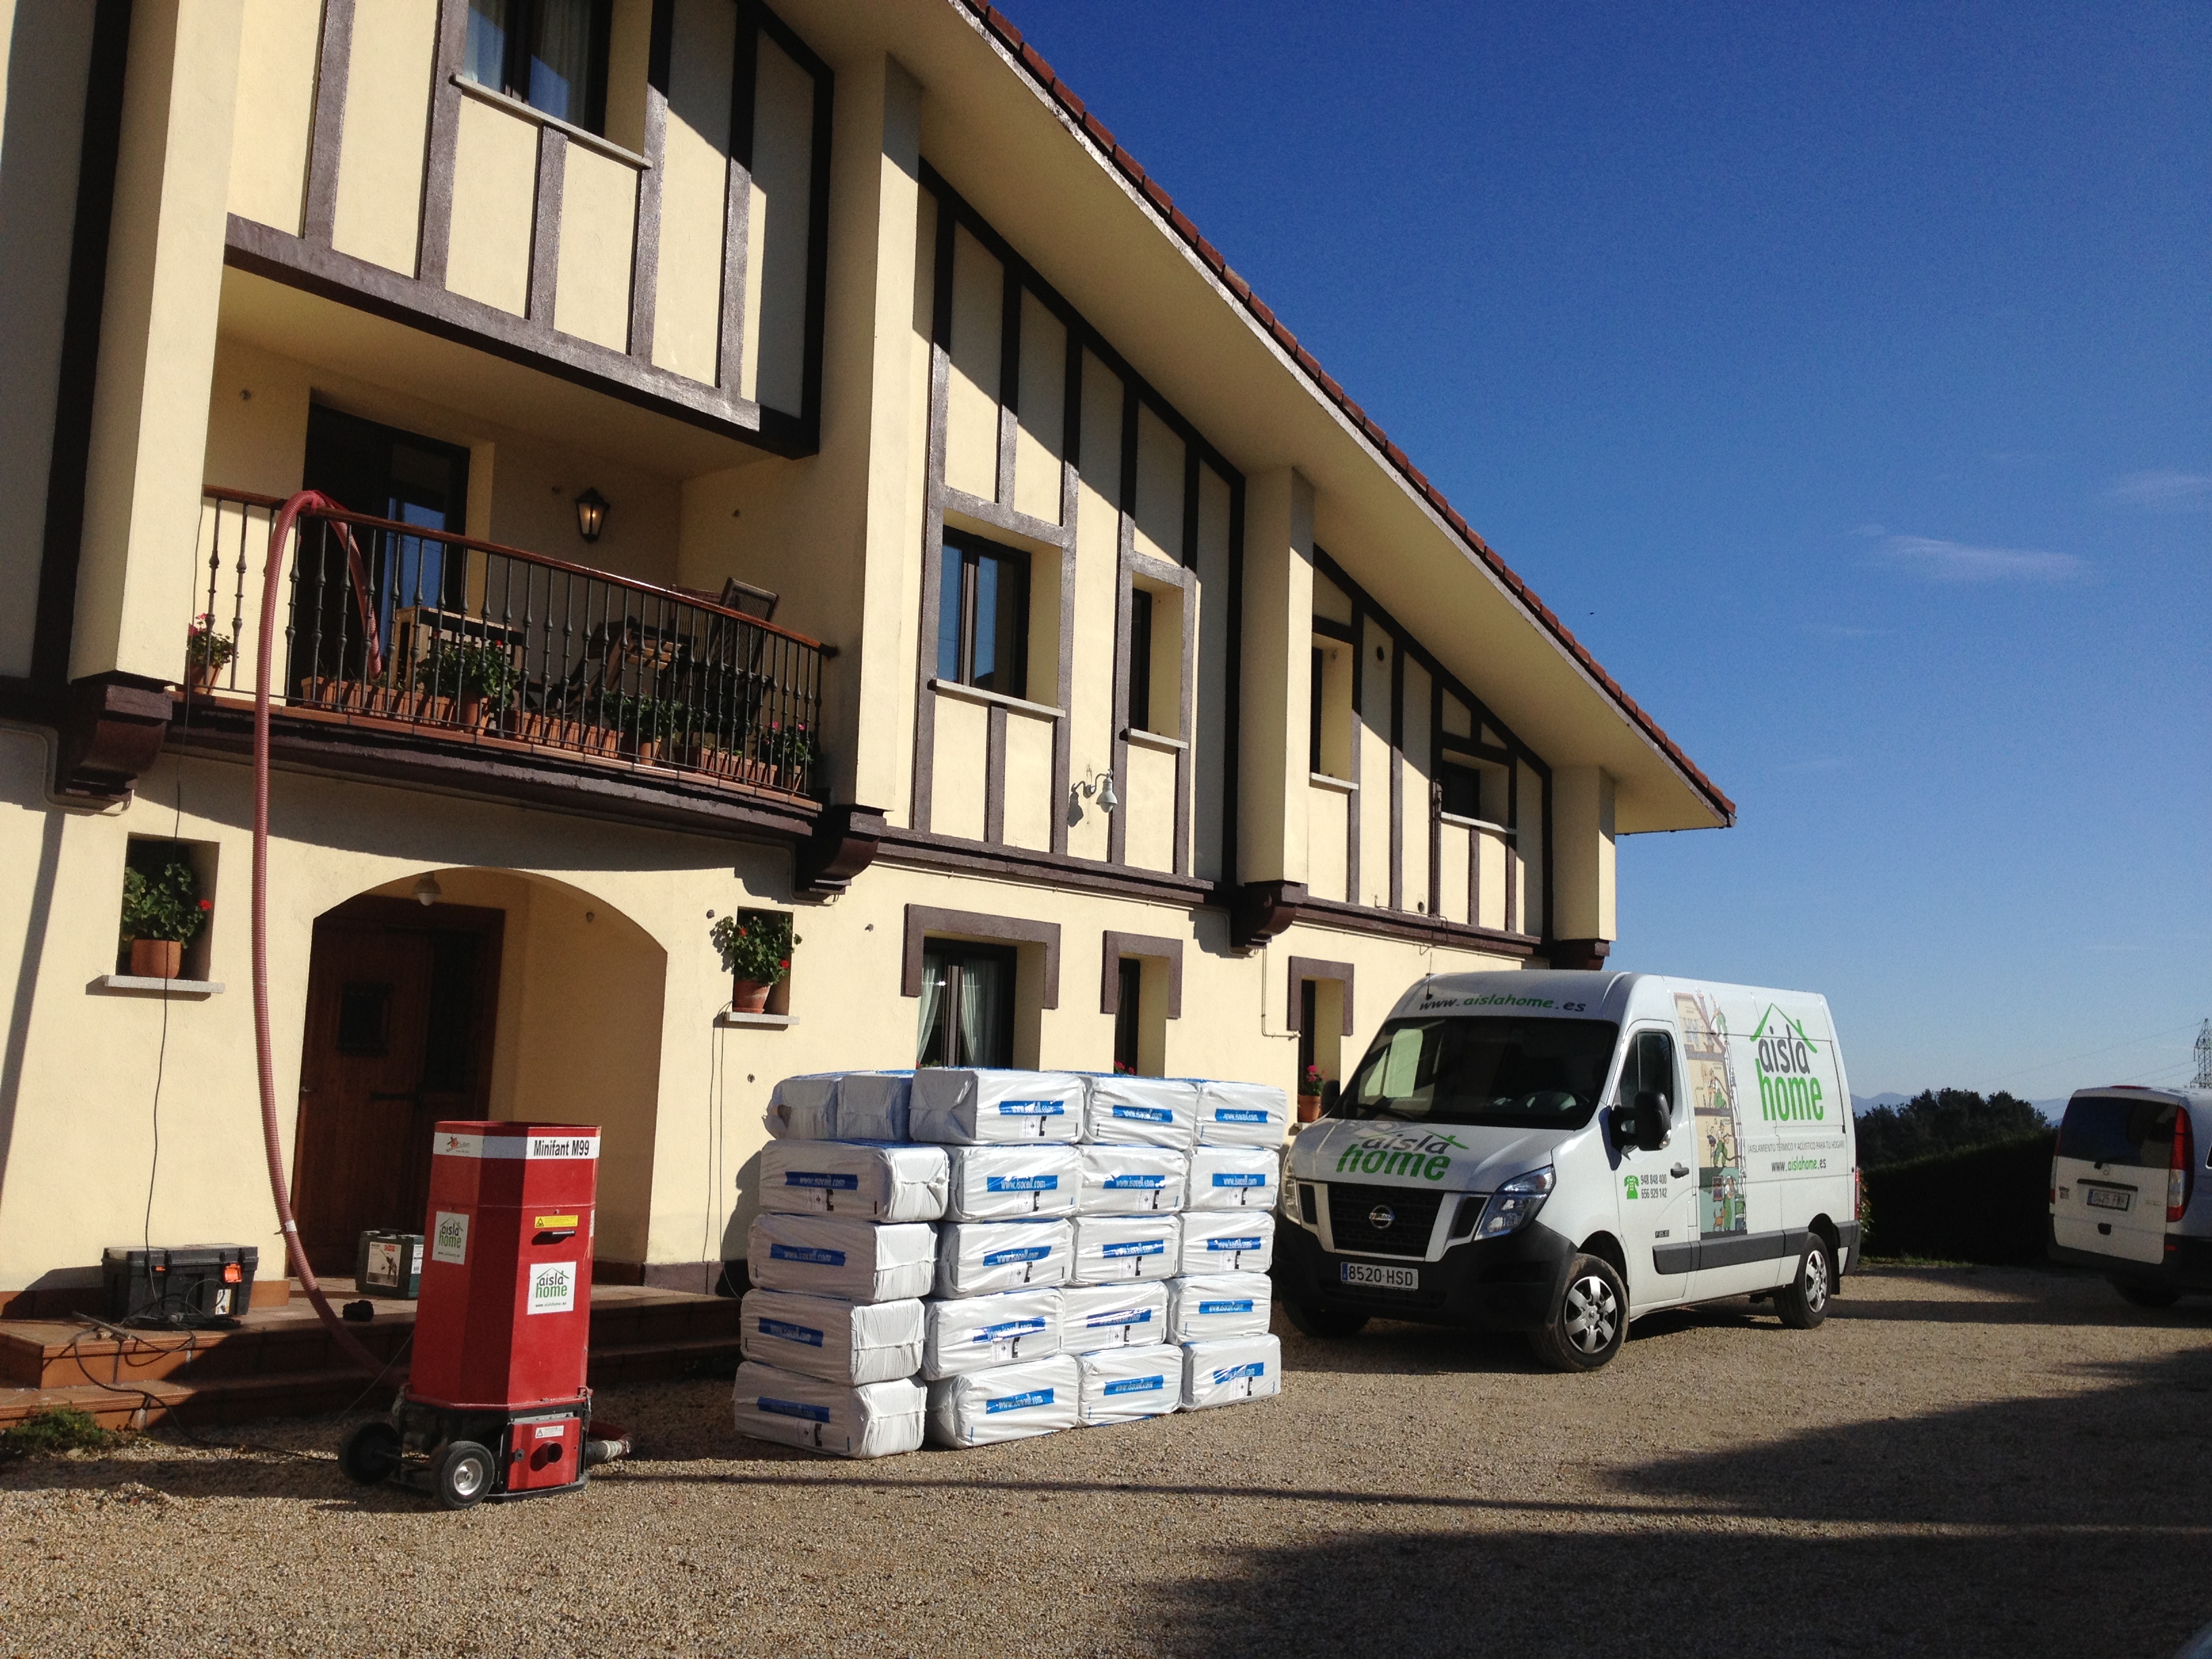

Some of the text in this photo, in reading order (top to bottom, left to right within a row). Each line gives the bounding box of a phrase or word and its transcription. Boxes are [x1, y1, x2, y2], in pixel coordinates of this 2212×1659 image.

[1758, 1024, 1811, 1074] aisla
[1755, 1057, 1824, 1122] home
[533, 1140, 590, 1156] Minifant M99
[1361, 1134, 1451, 1155] aisla
[1336, 1143, 1451, 1181] home
[1000, 1178, 1046, 1190] www.isocell.com
[1223, 1174, 1258, 1185] www.isocell.com
[1658, 1174, 1667, 1185] 400
[1659, 1187, 1667, 1198] 142
[441, 1223, 459, 1236] aisla
[438, 1230, 462, 1248] home
[539, 1272, 564, 1286] aisla
[1349, 1265, 1413, 1286] 8520 HSD
[535, 1282, 567, 1298] home
